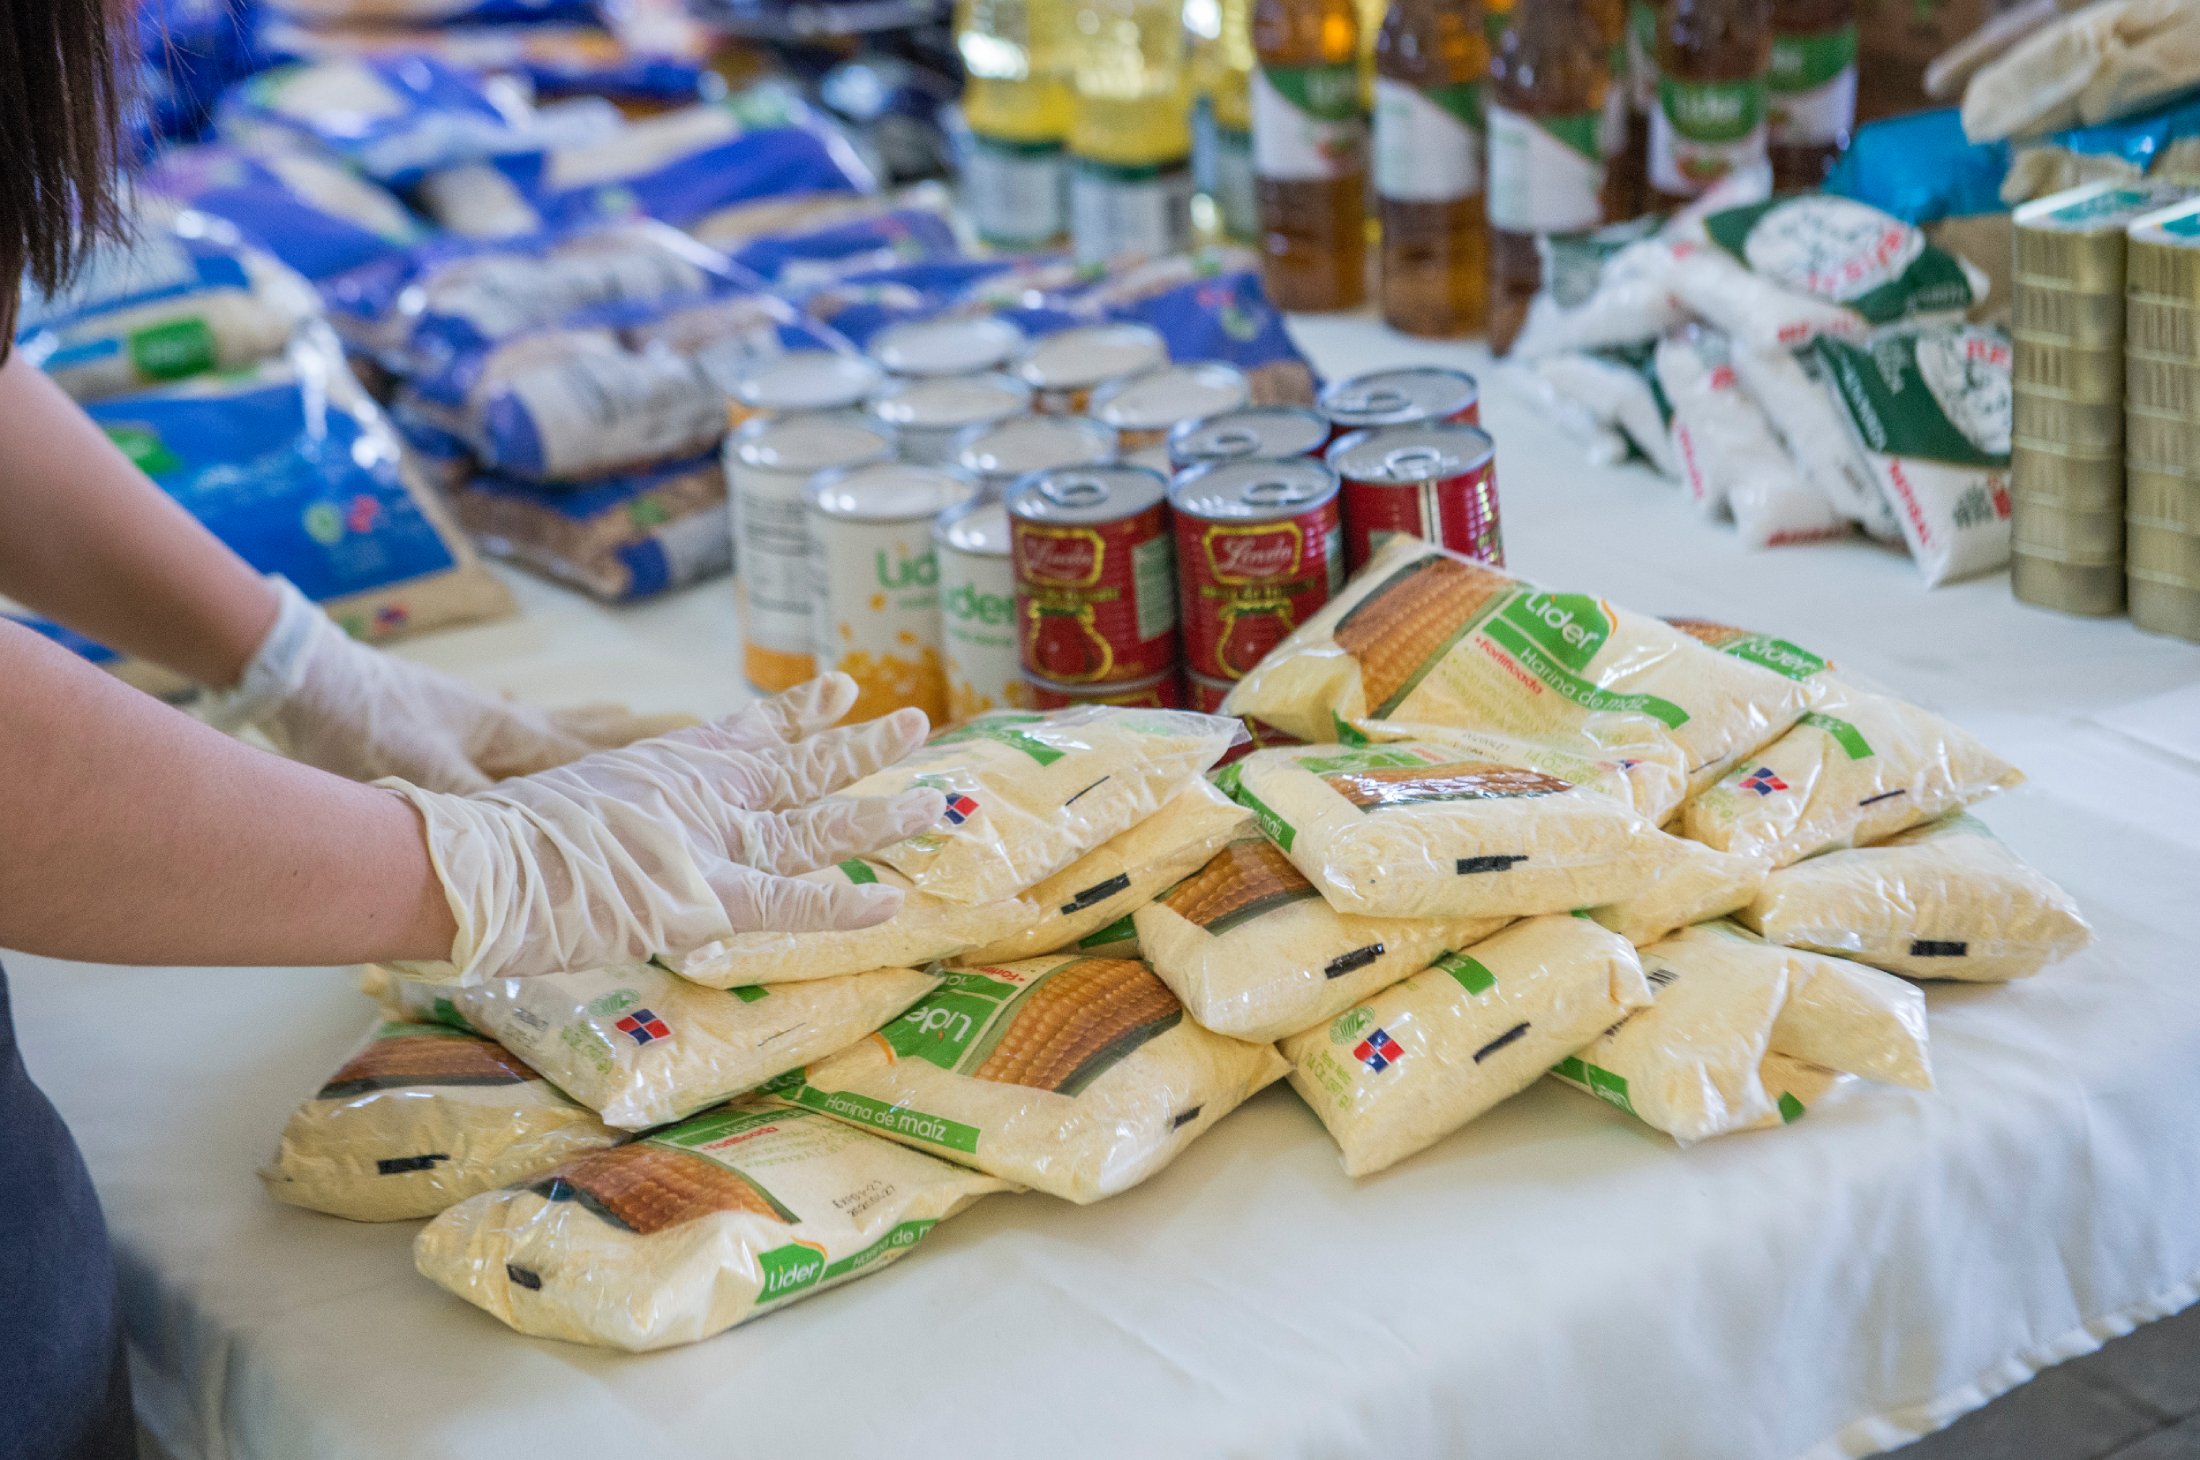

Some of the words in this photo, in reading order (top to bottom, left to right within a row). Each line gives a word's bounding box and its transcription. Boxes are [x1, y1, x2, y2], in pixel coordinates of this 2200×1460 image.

[1525, 592, 1600, 650] Lider
[1519, 647, 1577, 698] Harina
[1578, 688, 1604, 709] de
[904, 1004, 972, 1043] Lide
[825, 1095, 871, 1120] Harina
[875, 1110, 895, 1126] de
[898, 1113, 948, 1142] maíz
[769, 1260, 819, 1293] Lider
